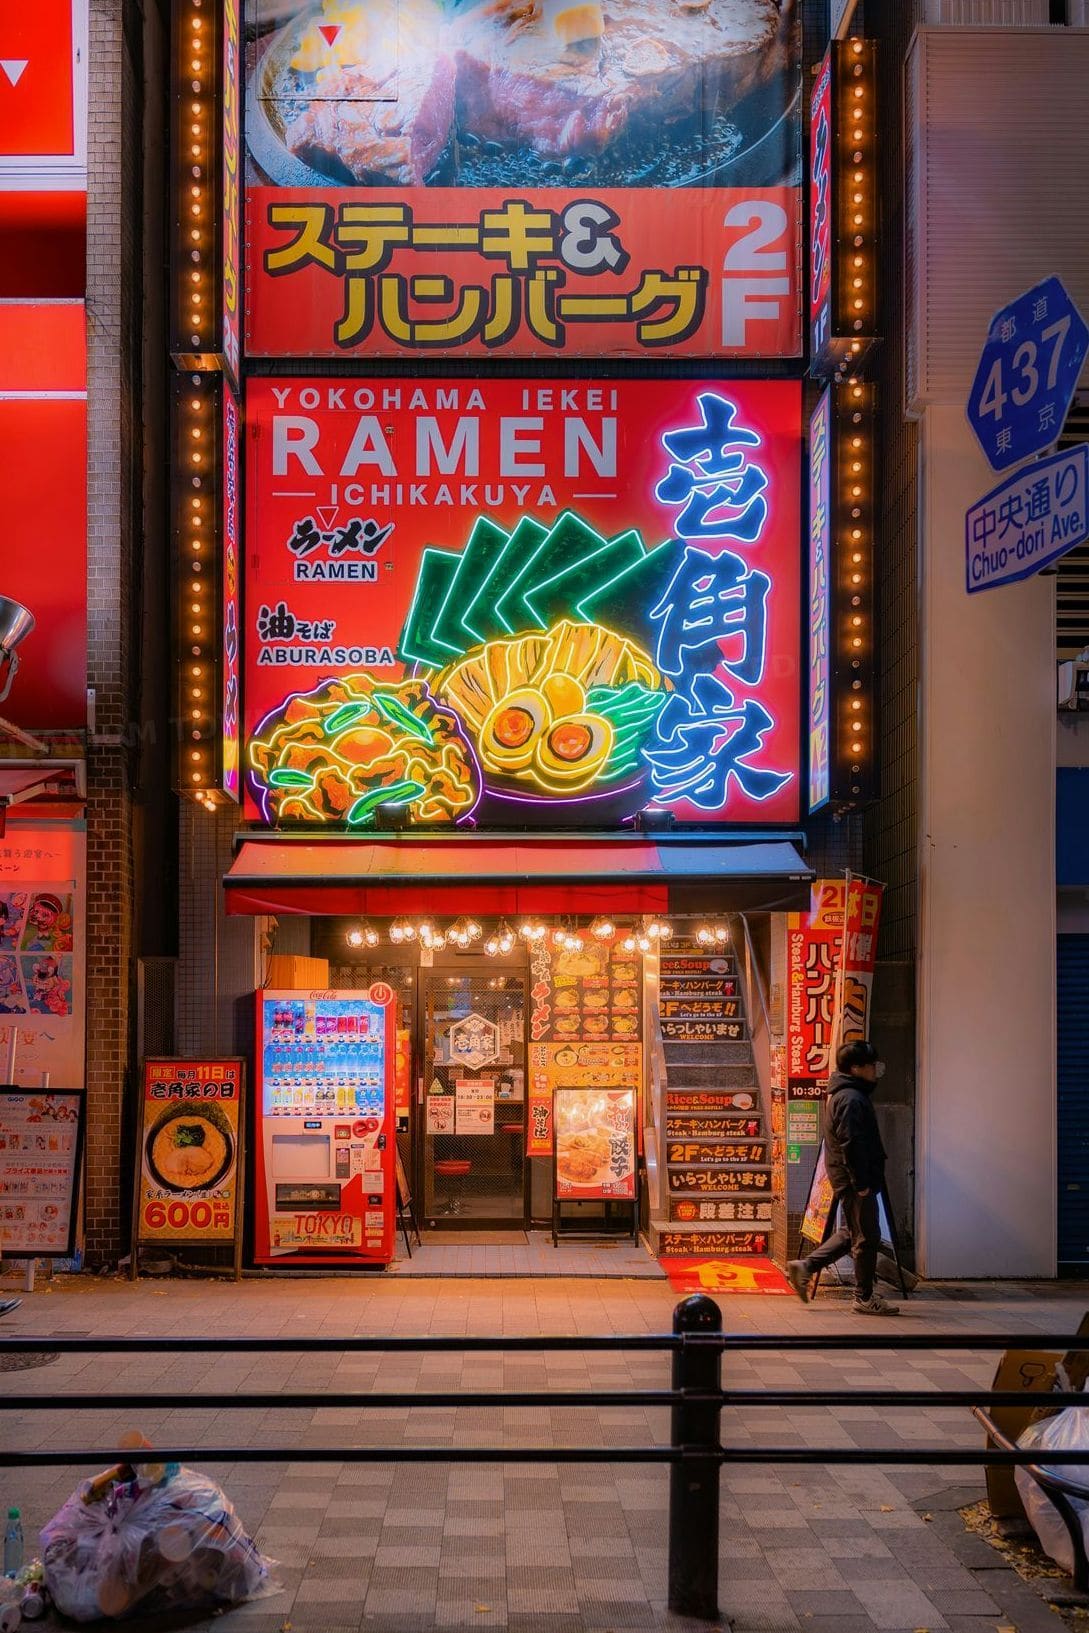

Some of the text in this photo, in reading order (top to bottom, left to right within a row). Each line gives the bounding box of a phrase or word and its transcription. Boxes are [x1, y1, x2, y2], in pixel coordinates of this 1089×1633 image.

[263, 199, 631, 276] ステーキ&
[334, 266, 710, 348] ハンバーグ
[978, 314, 1072, 421] 437
[271, 388, 619, 411] YOKOHAMA IEKEI
[271, 415, 619, 478] RAMEN
[330, 484, 558, 506] ICHIKAKUYA
[972, 463, 1079, 549] 中央通り
[288, 516, 396, 558] ラーメン
[971, 513, 1084, 582] Chuo-dori Ave.
[295, 562, 377, 580] RAMEN
[640, 391, 795, 810] 壱角家
[257, 602, 335, 642] 油そば
[259, 647, 394, 665] ABURASOBA
[661, 958, 711, 971] ce&Soup
[660, 980, 724, 990] テーキ×ハンバーグ
[805, 943, 832, 1072] ハンバーグ
[790, 1036, 804, 1074] Steak
[150, 1081, 236, 1099] 壱角家の日
[294, 1215, 354, 1235] TOKYO
